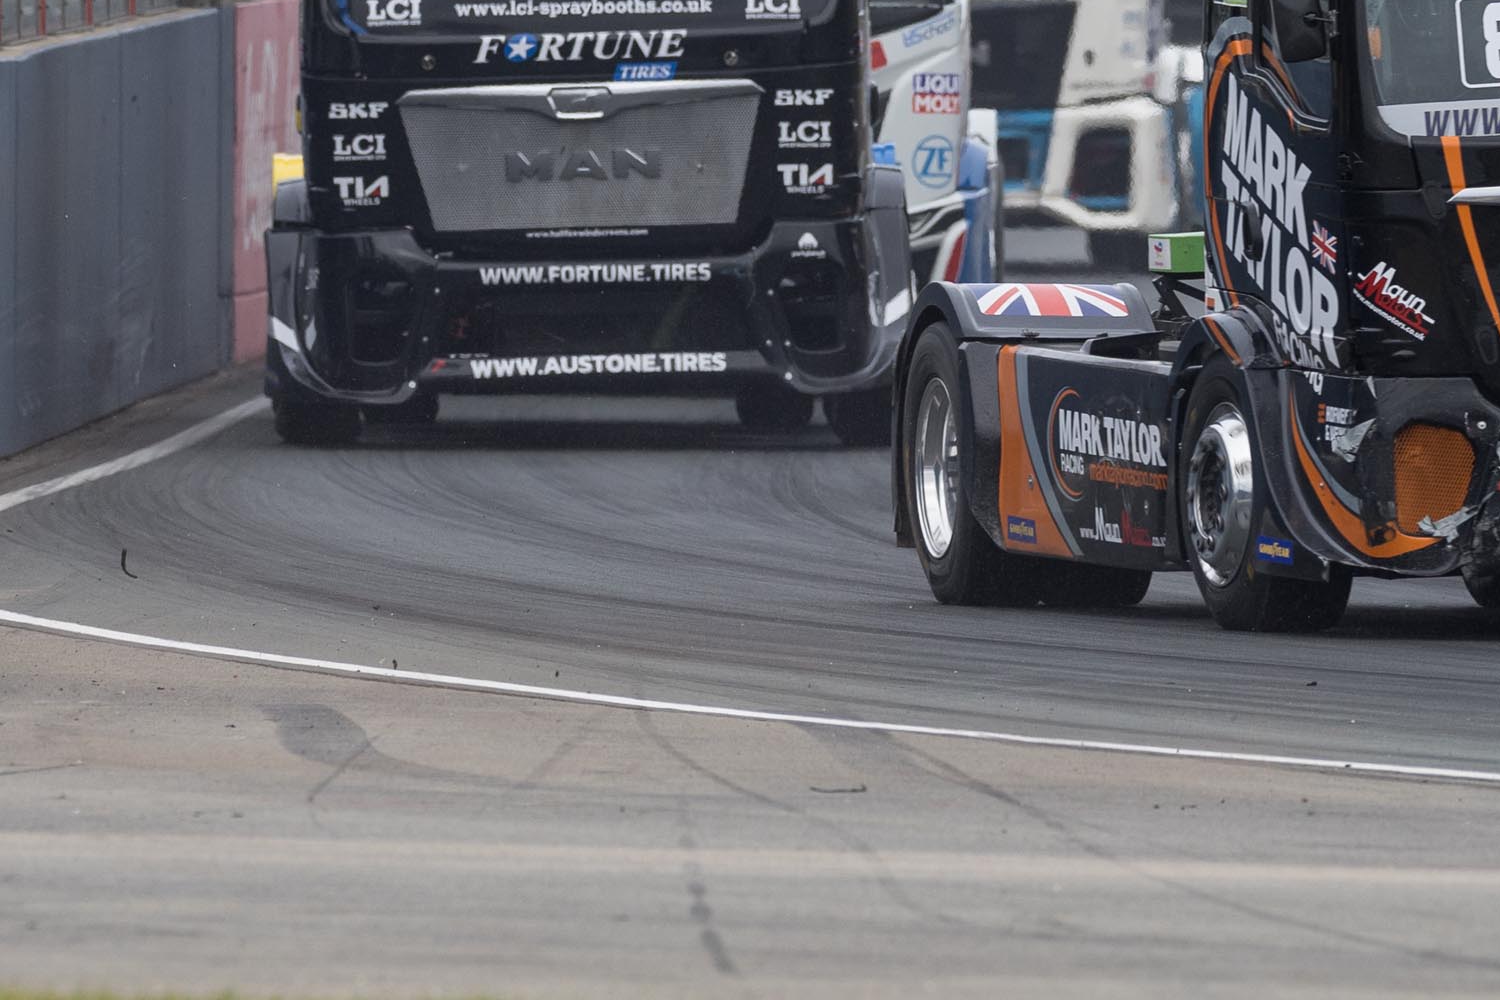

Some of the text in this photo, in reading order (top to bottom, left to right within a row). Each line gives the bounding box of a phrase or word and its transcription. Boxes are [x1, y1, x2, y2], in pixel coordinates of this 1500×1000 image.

[472, 28, 688, 64] FORTUNE
[619, 64, 672, 79] TIRES
[774, 89, 835, 106] SKF
[328, 101, 389, 119] SKF
[778, 120, 832, 143] LCI
[333, 133, 387, 155] LCI
[504, 149, 662, 184] MAN
[1222, 72, 1312, 251] MARK
[479, 263, 712, 285] WWW.FORTUNE.TIRES
[1357, 261, 1432, 318] Maun
[470, 352, 727, 379] WWW.AUSTONE.TIRES
[1058, 408, 1168, 467] MARK TAYLOR
[1060, 453, 1085, 475] RACING
